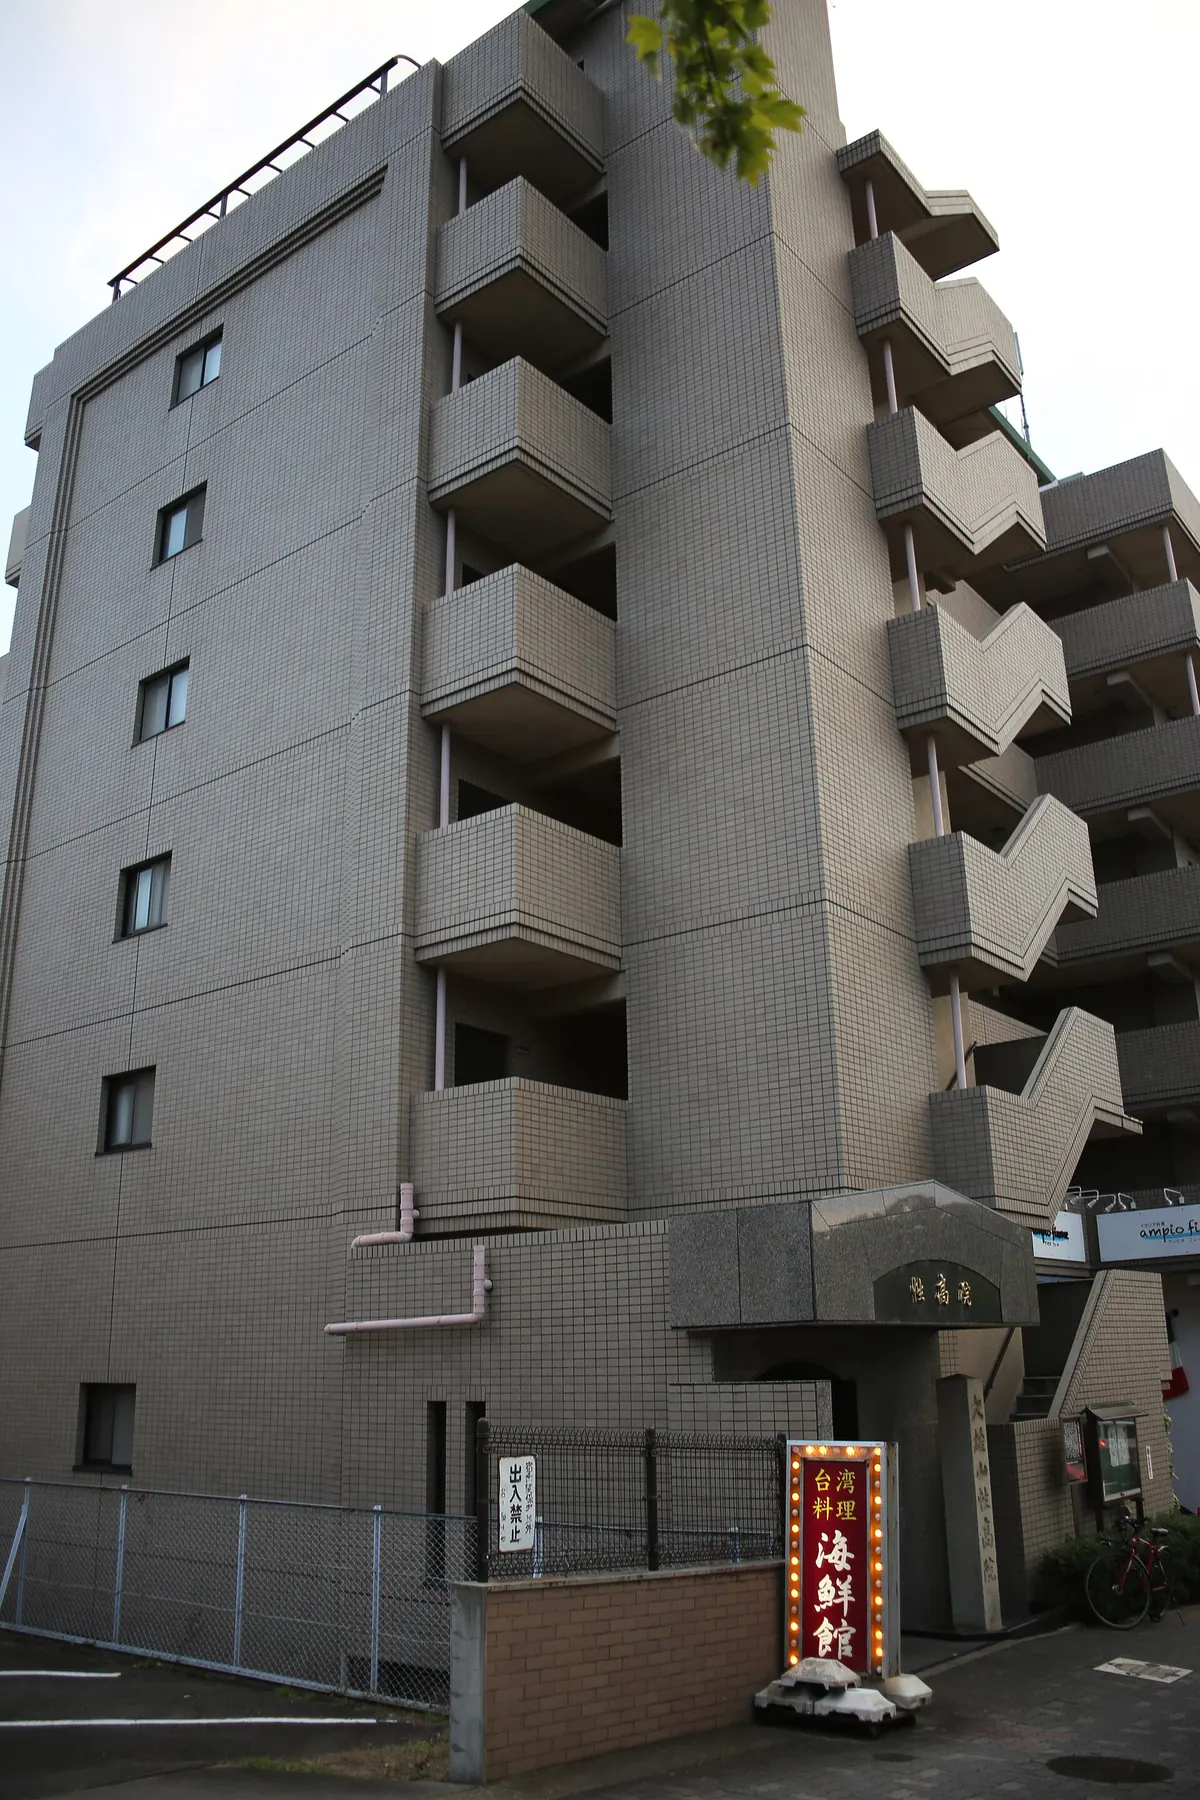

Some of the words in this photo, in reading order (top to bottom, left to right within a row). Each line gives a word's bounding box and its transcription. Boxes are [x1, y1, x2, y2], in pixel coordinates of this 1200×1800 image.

[1139, 1224, 1185, 1243] ampio
[813, 1468, 856, 1494] 台湾
[509, 1463, 522, 1544] 出入禁止
[812, 1496, 857, 1521] 料理
[813, 1529, 857, 1661] 海鮮館
